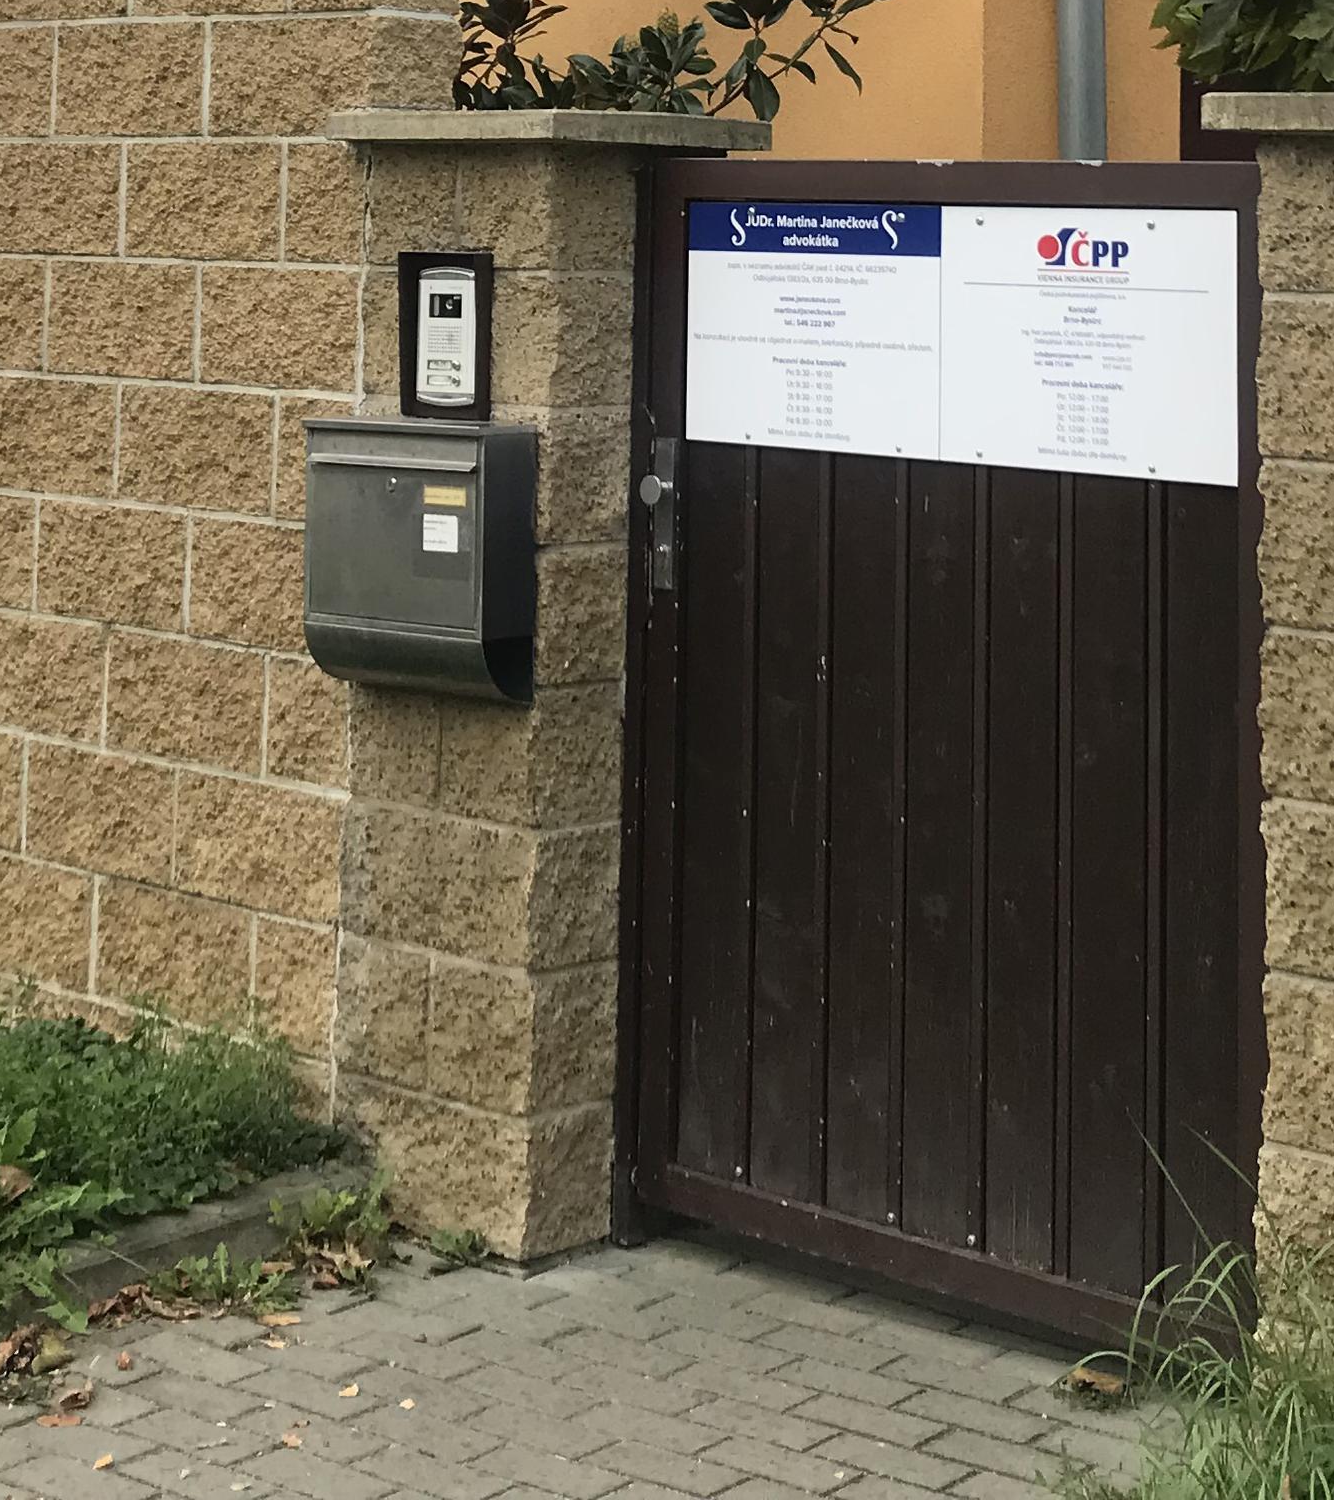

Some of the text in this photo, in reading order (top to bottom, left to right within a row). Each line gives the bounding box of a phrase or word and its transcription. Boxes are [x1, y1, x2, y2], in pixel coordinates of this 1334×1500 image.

[745, 214, 880, 230] JUDr. Martina Janečková
[782, 234, 840, 248] advokátka
[1071, 230, 1130, 268] ČPP
